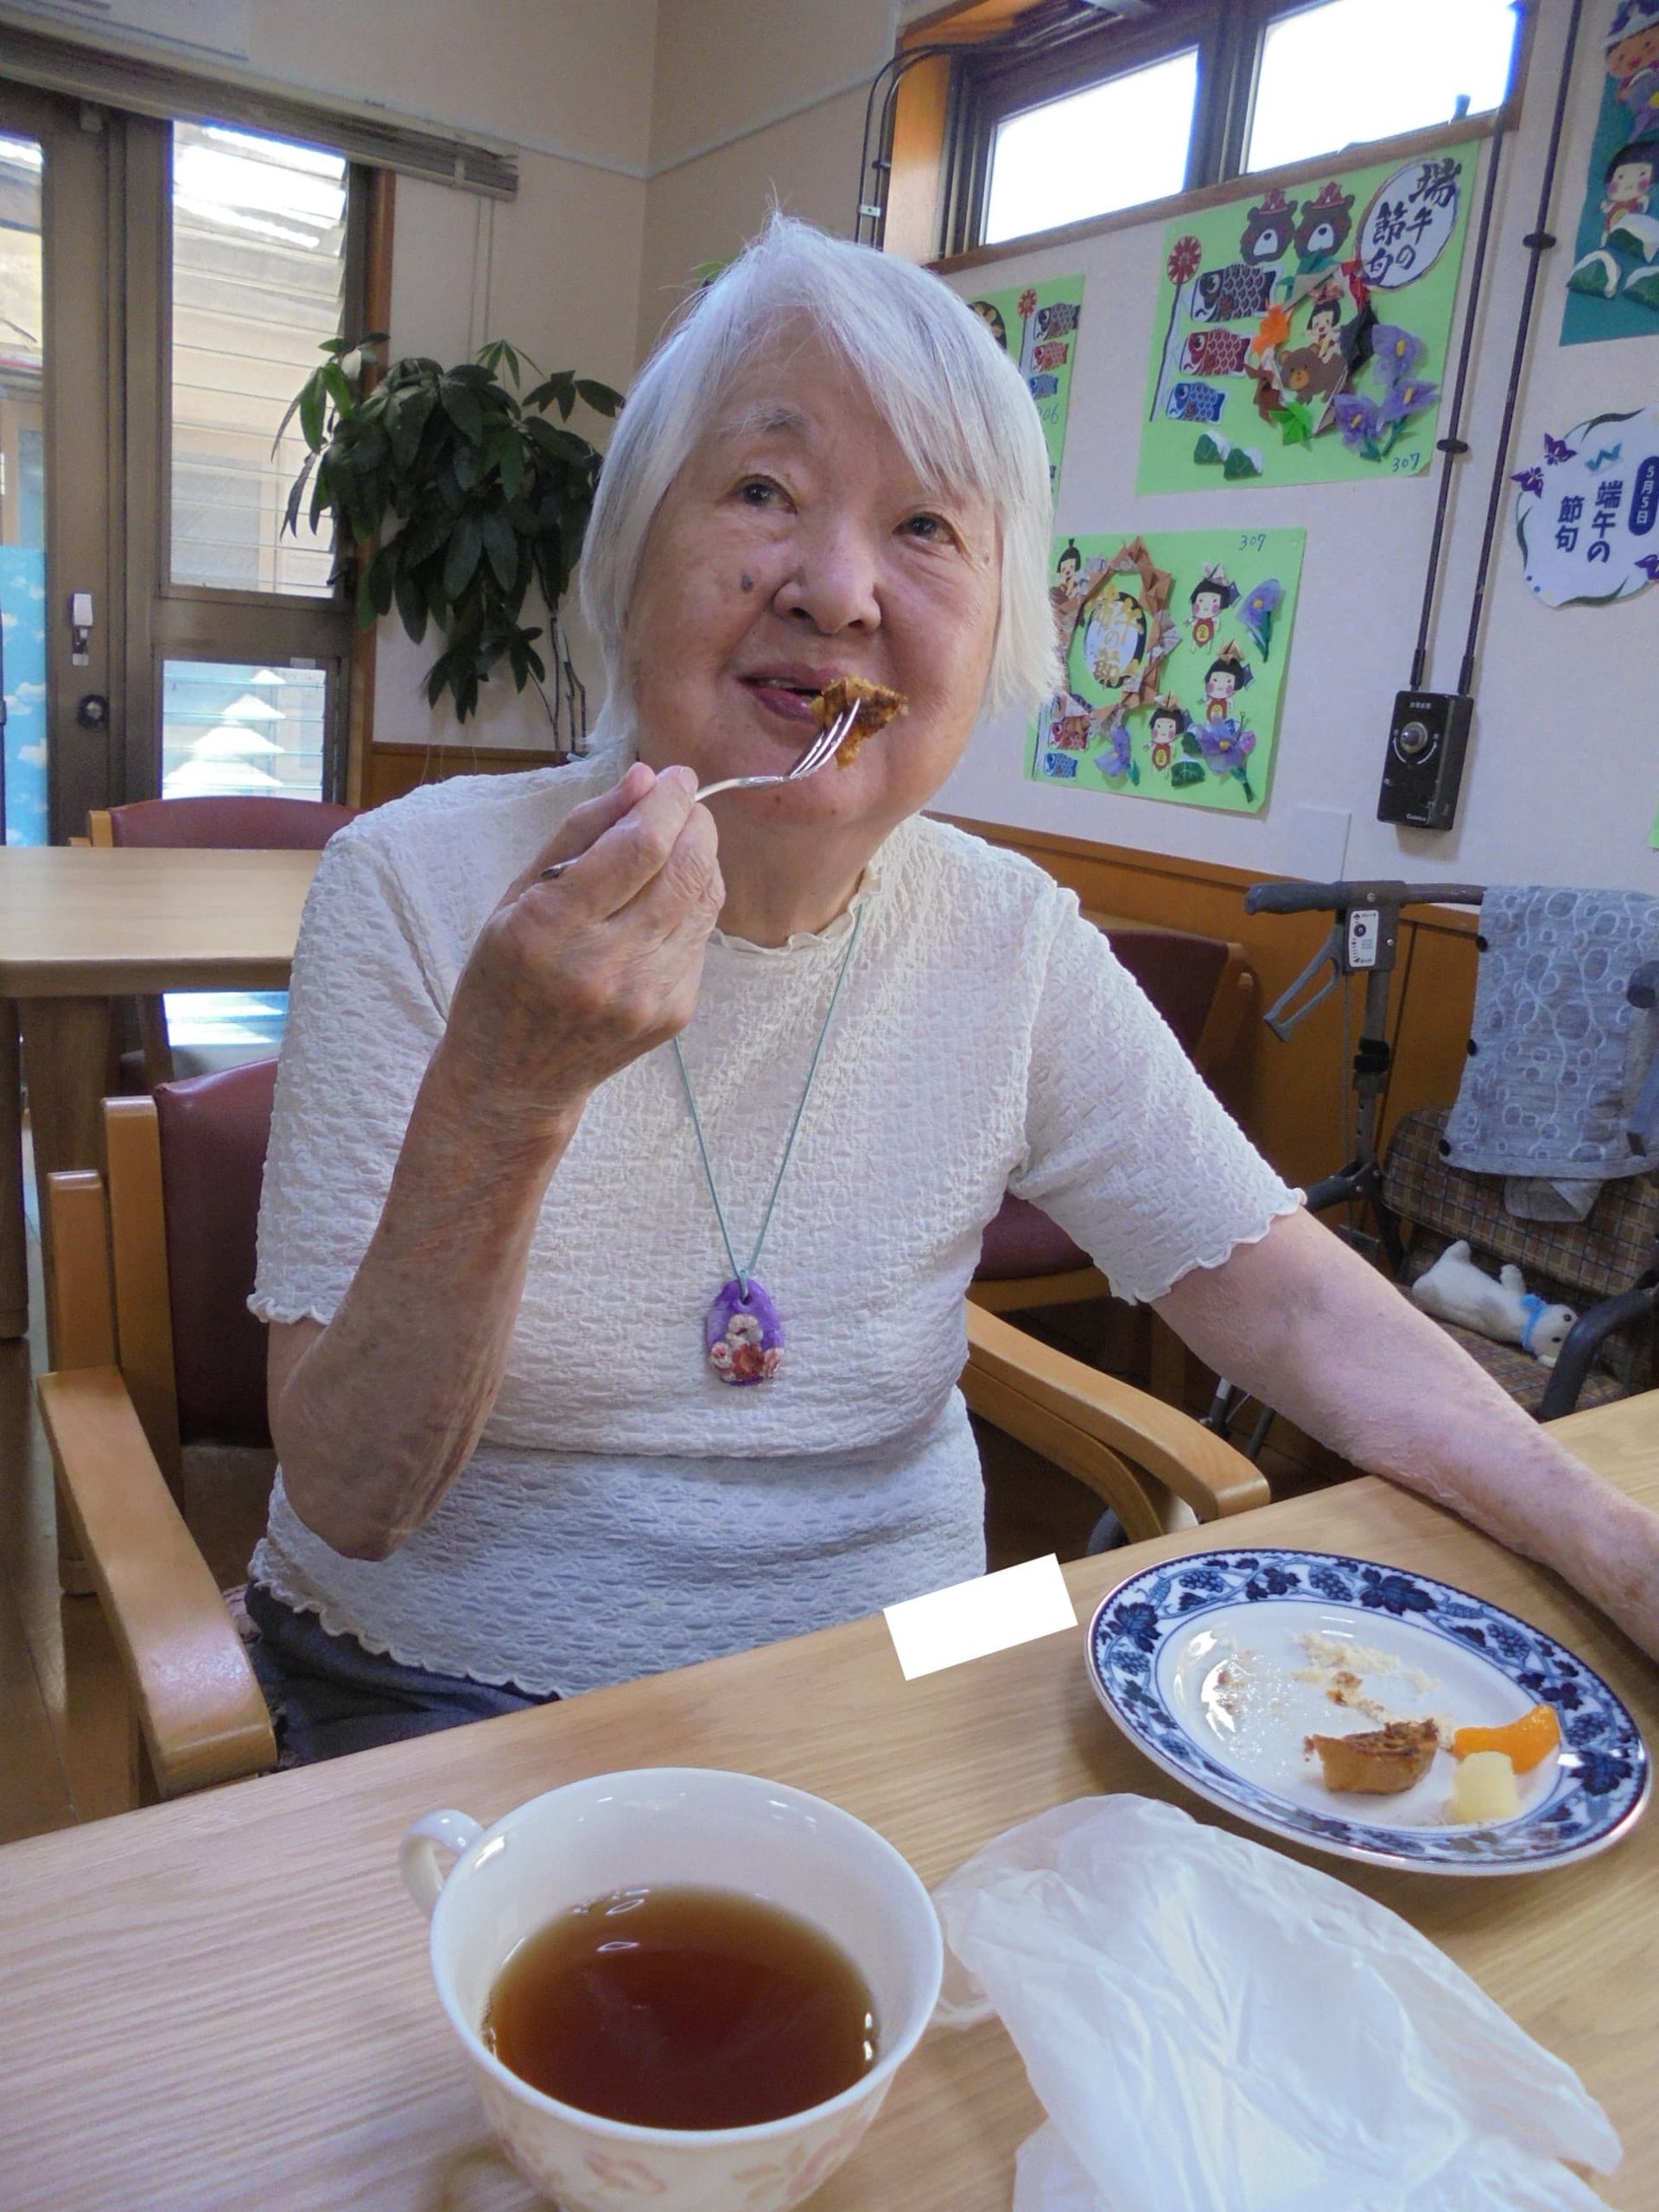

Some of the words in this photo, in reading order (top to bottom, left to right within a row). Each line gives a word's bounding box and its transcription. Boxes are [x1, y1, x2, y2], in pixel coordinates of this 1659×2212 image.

[1363, 200, 1408, 285] 節句
[1392, 452, 1421, 473] 307
[1554, 495, 1585, 553] 節句
[1587, 480, 1624, 563] 端午の
[1636, 465, 1655, 525] 5月5日
[1238, 533, 1267, 552] 307
